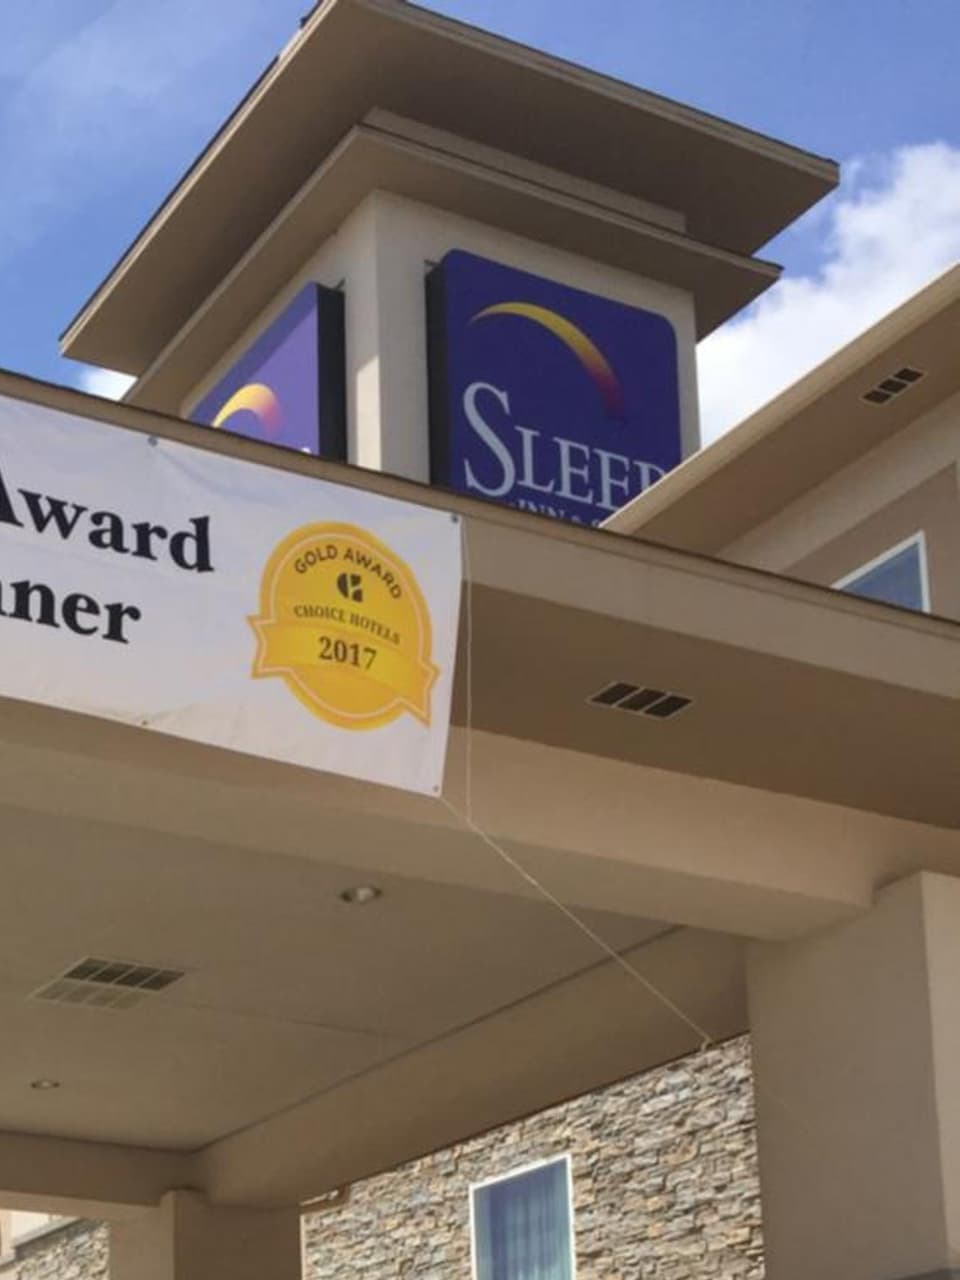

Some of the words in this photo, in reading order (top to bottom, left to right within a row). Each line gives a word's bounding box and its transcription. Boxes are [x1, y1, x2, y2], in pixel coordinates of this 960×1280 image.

[294, 544, 338, 574] GOLD
[343, 547, 403, 600] AWARD
[293, 605, 347, 624] CHOICE
[349, 613, 401, 646] HOTELS
[318, 636, 377, 670] 2017
